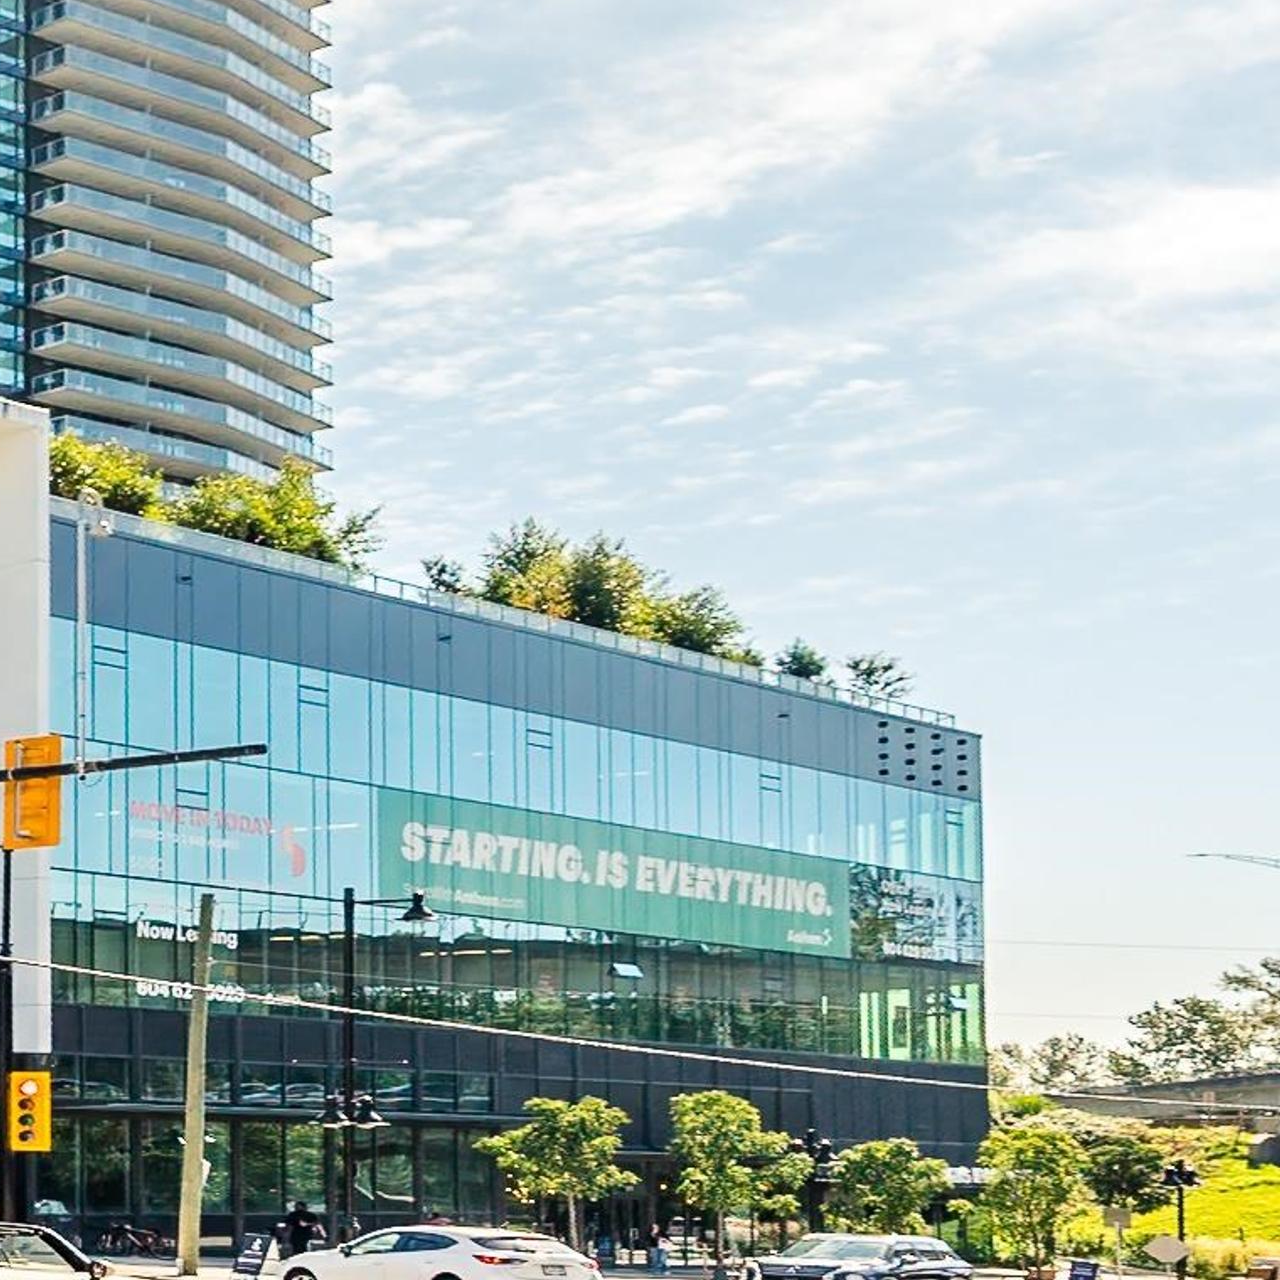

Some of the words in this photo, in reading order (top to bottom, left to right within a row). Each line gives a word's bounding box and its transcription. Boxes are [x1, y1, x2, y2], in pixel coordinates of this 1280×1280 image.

[401, 821, 591, 884] STARTING.
[595, 849, 628, 889] IS
[636, 855, 833, 917] EVERYTHING.
[137, 921, 173, 940] Now
[176, 926, 238, 949] Leing
